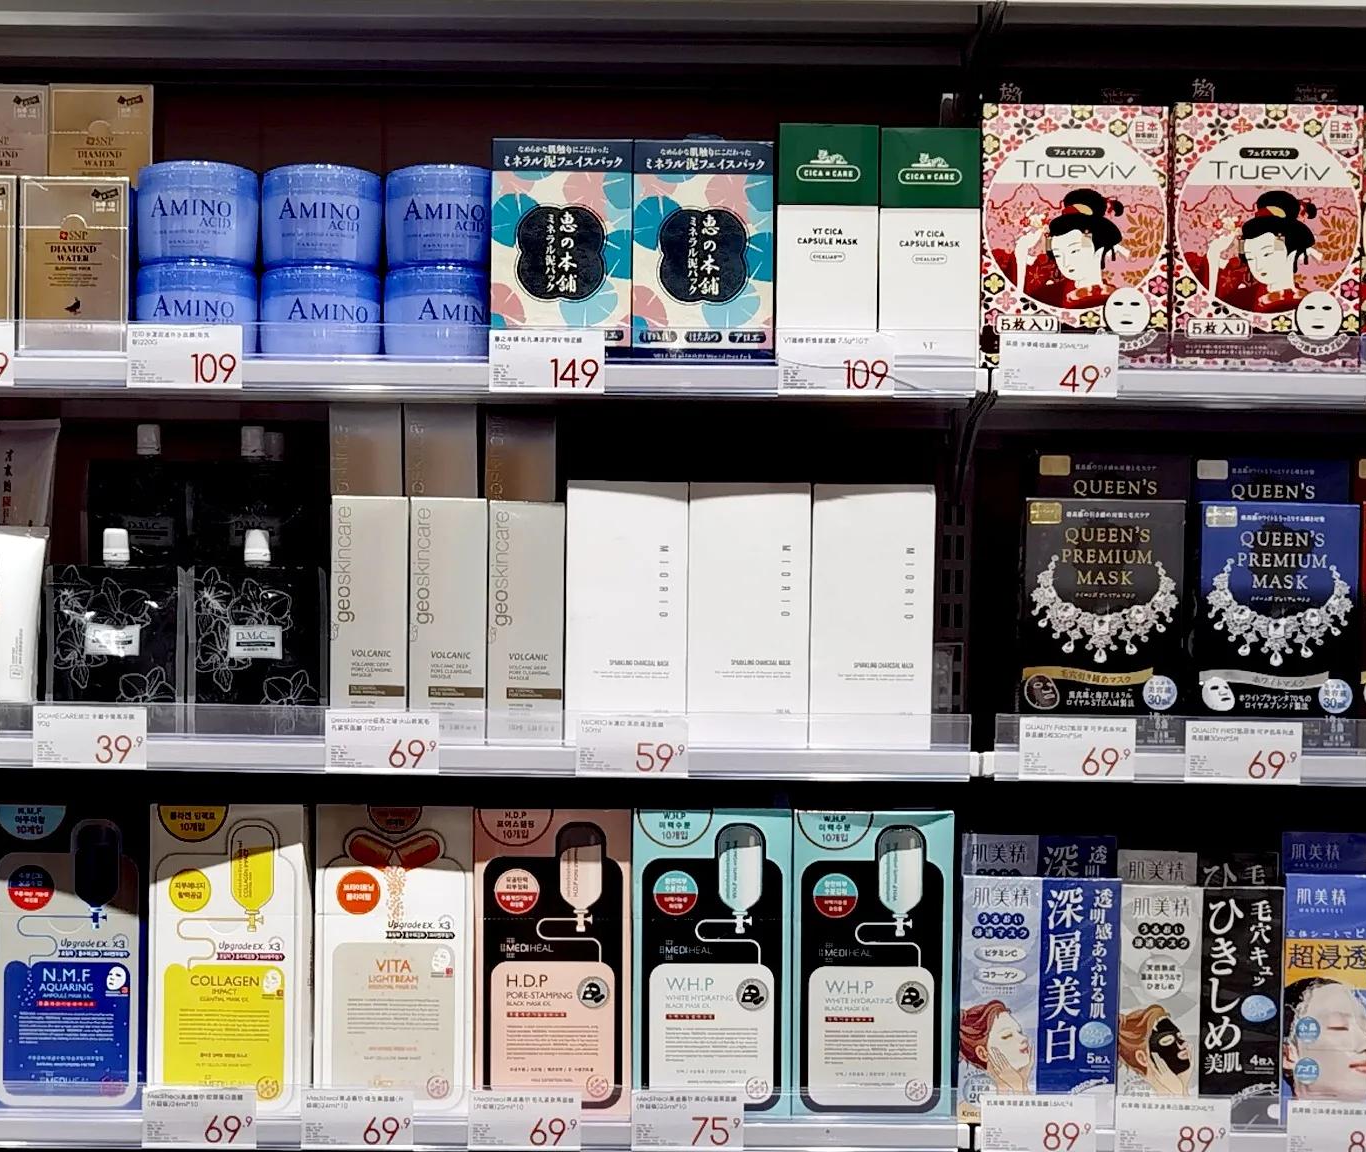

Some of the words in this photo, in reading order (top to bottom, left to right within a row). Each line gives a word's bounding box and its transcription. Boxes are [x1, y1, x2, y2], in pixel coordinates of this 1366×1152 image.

[1210, 160, 1329, 184] Trueviv
[279, 196, 360, 221] AMINO
[68, 230, 88, 240] SNP
[813, 228, 823, 236] VT
[825, 228, 843, 236] CICA
[797, 237, 832, 246] CAPSULE
[835, 237, 858, 246] MASK
[192, 353, 236, 384] 109
[550, 358, 598, 388] 149
[843, 359, 888, 390] 109
[1065, 528, 1151, 546] QUEEN'S
[1240, 530, 1325, 549] QUEEN'S
[337, 506, 355, 623] geoskincare
[1061, 549, 1154, 566] PREMIUM
[1236, 552, 1328, 570] PREMIUM
[1076, 569, 1133, 586] MASK
[1252, 573, 1308, 590] MASK
[351, 649, 391, 659] VOLCANIC
[431, 651, 471, 661] VOLCANIC
[1089, 889, 1113, 1019] 透明感あふれる肌
[376, 959, 413, 974] VITA
[1203, 898, 1244, 1051] ひきしめ
[190, 974, 260, 989] COLLAGEN
[506, 974, 549, 989] H.D.P
[1045, 887, 1083, 1065] 深層美白
[825, 980, 875, 994] W.H.P
[506, 991, 573, 1002] PORE-STAMPING
[1086, 1053, 1110, 1064] 5枚入
[1250, 1056, 1274, 1066] 4枚入
